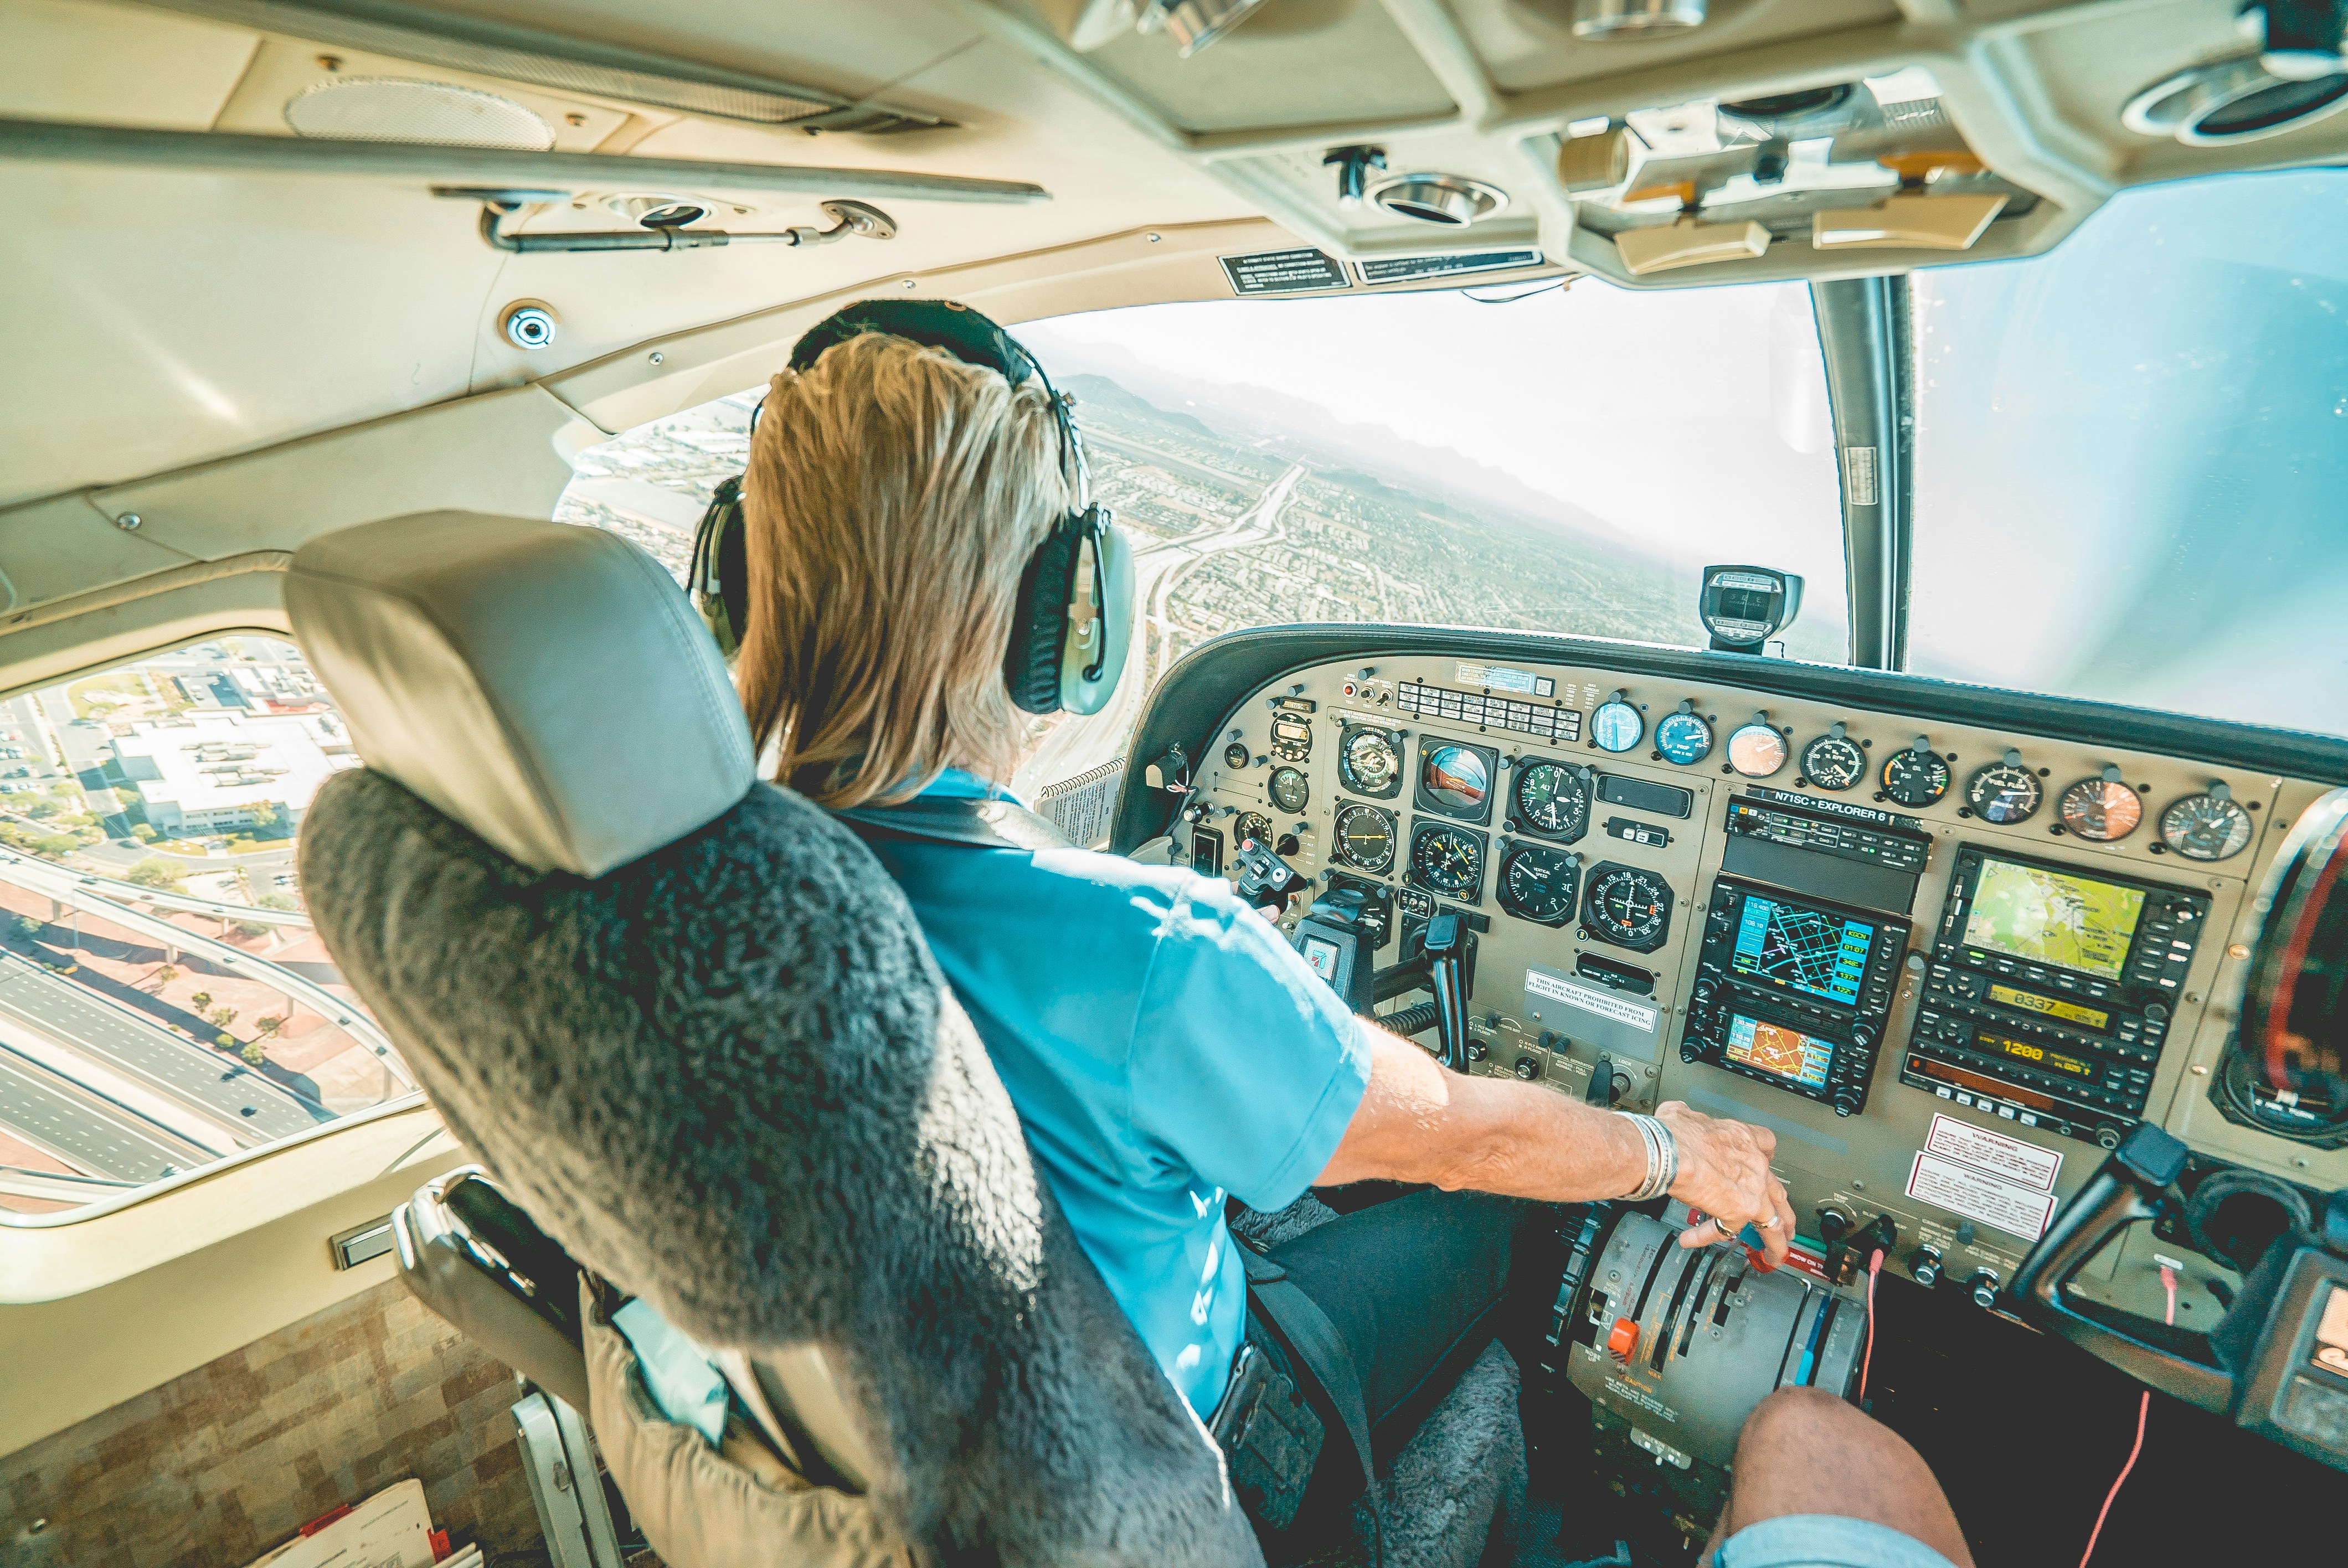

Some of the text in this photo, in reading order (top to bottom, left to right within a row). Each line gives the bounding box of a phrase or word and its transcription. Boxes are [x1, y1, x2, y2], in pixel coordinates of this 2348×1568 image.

[1988, 778, 2006, 786] FUEL
[1775, 791, 1886, 821] N71SC EXPLORER 6
[1651, 887, 1660, 896] 24
[1657, 902, 1664, 911] 27
[1652, 916, 1661, 925] 30
[1844, 945, 1865, 953] 01:07
[1529, 981, 1551, 992] FLIGHT
[1561, 992, 1584, 1004] KNOWN
[1596, 1003, 1630, 1017] FORECAST
[1631, 1015, 1651, 1025] ICING
[1551, 983, 1583, 996] AIRCRAFT
[1584, 993, 1623, 1010] PROHIBITED
[1624, 1007, 1645, 1017] FROM
[2002, 1040, 2043, 1061] 1200
[1552, 1052, 1594, 1070] INERTIAL SEPARATOR
[1557, 1059, 1573, 1068] BYPASS
[1618, 1058, 1632, 1066] LOCK
[1555, 1062, 1573, 1071] NORMAL
[1972, 1132, 2019, 1152] WARNING
[1963, 1173, 2004, 1190] WARNING
